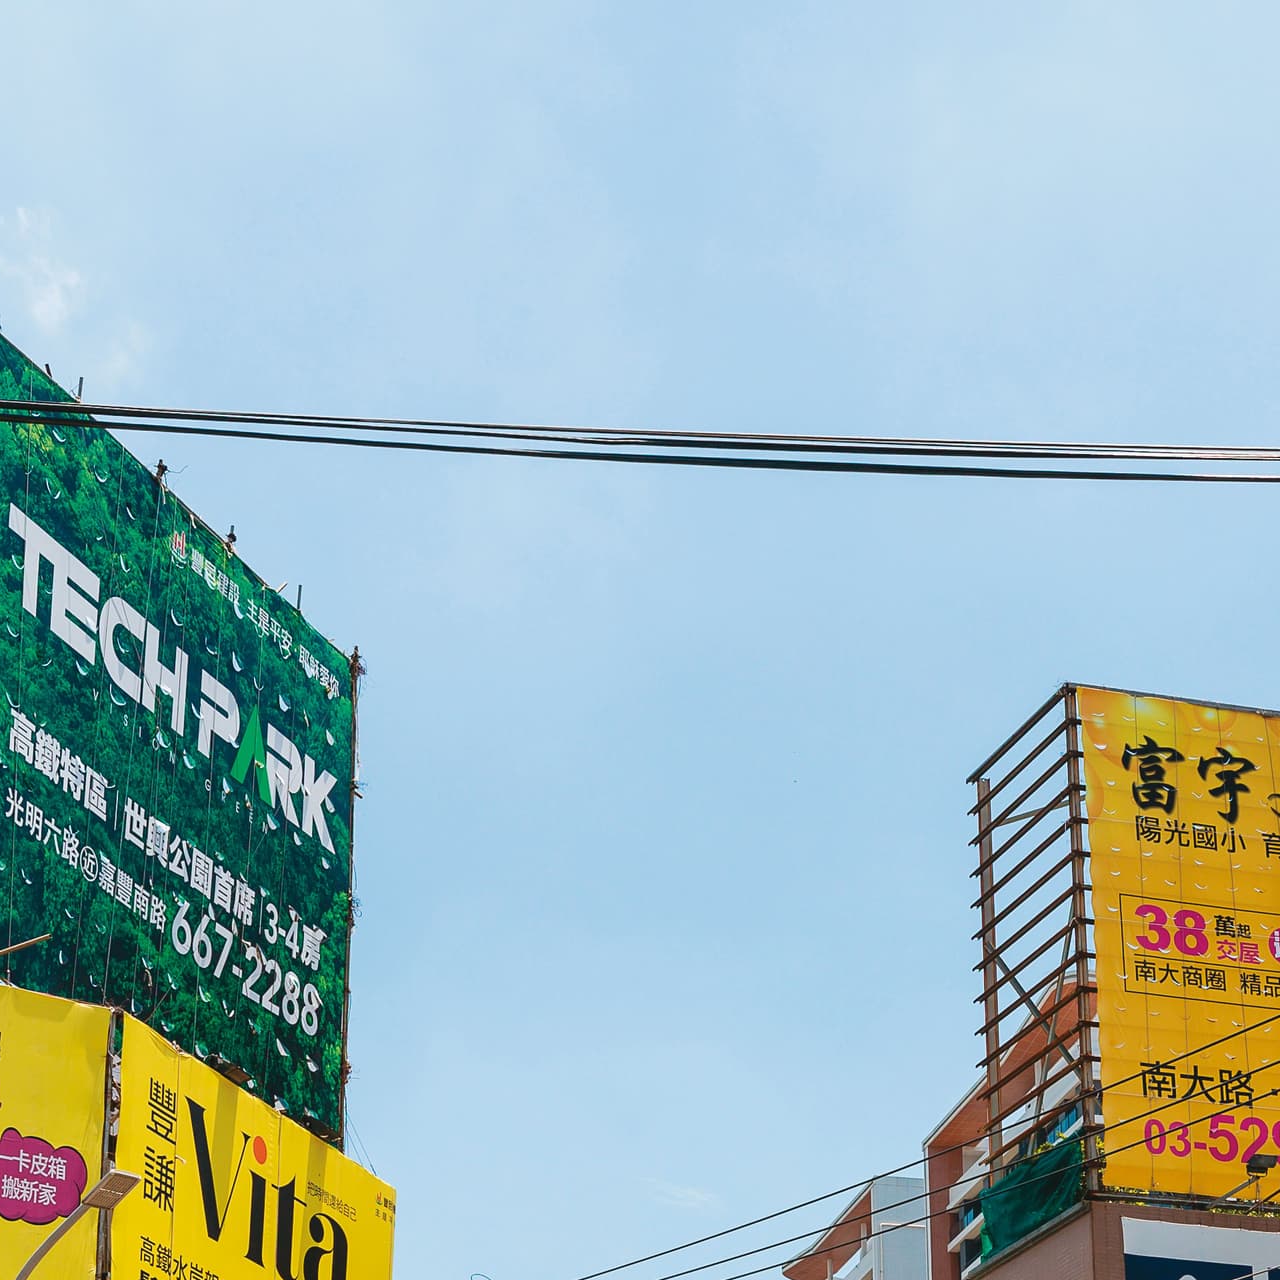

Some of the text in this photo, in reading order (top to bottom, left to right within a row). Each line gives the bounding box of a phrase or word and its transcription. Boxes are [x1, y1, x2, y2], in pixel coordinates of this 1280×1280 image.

[9, 502, 337, 855] TECH PARK
[8, 707, 108, 822] 高鐵特區
[1135, 815, 1247, 854] 陽光國小
[1134, 904, 1210, 956] 38
[1215, 914, 1252, 939] 萬起
[1217, 939, 1260, 965] 交屋
[171, 899, 322, 1037] 667-2288
[1134, 960, 1227, 993] 南大商圈
[1140, 1060, 1255, 1109] 南大路
[1, 1176, 58, 1207] 搬新家
